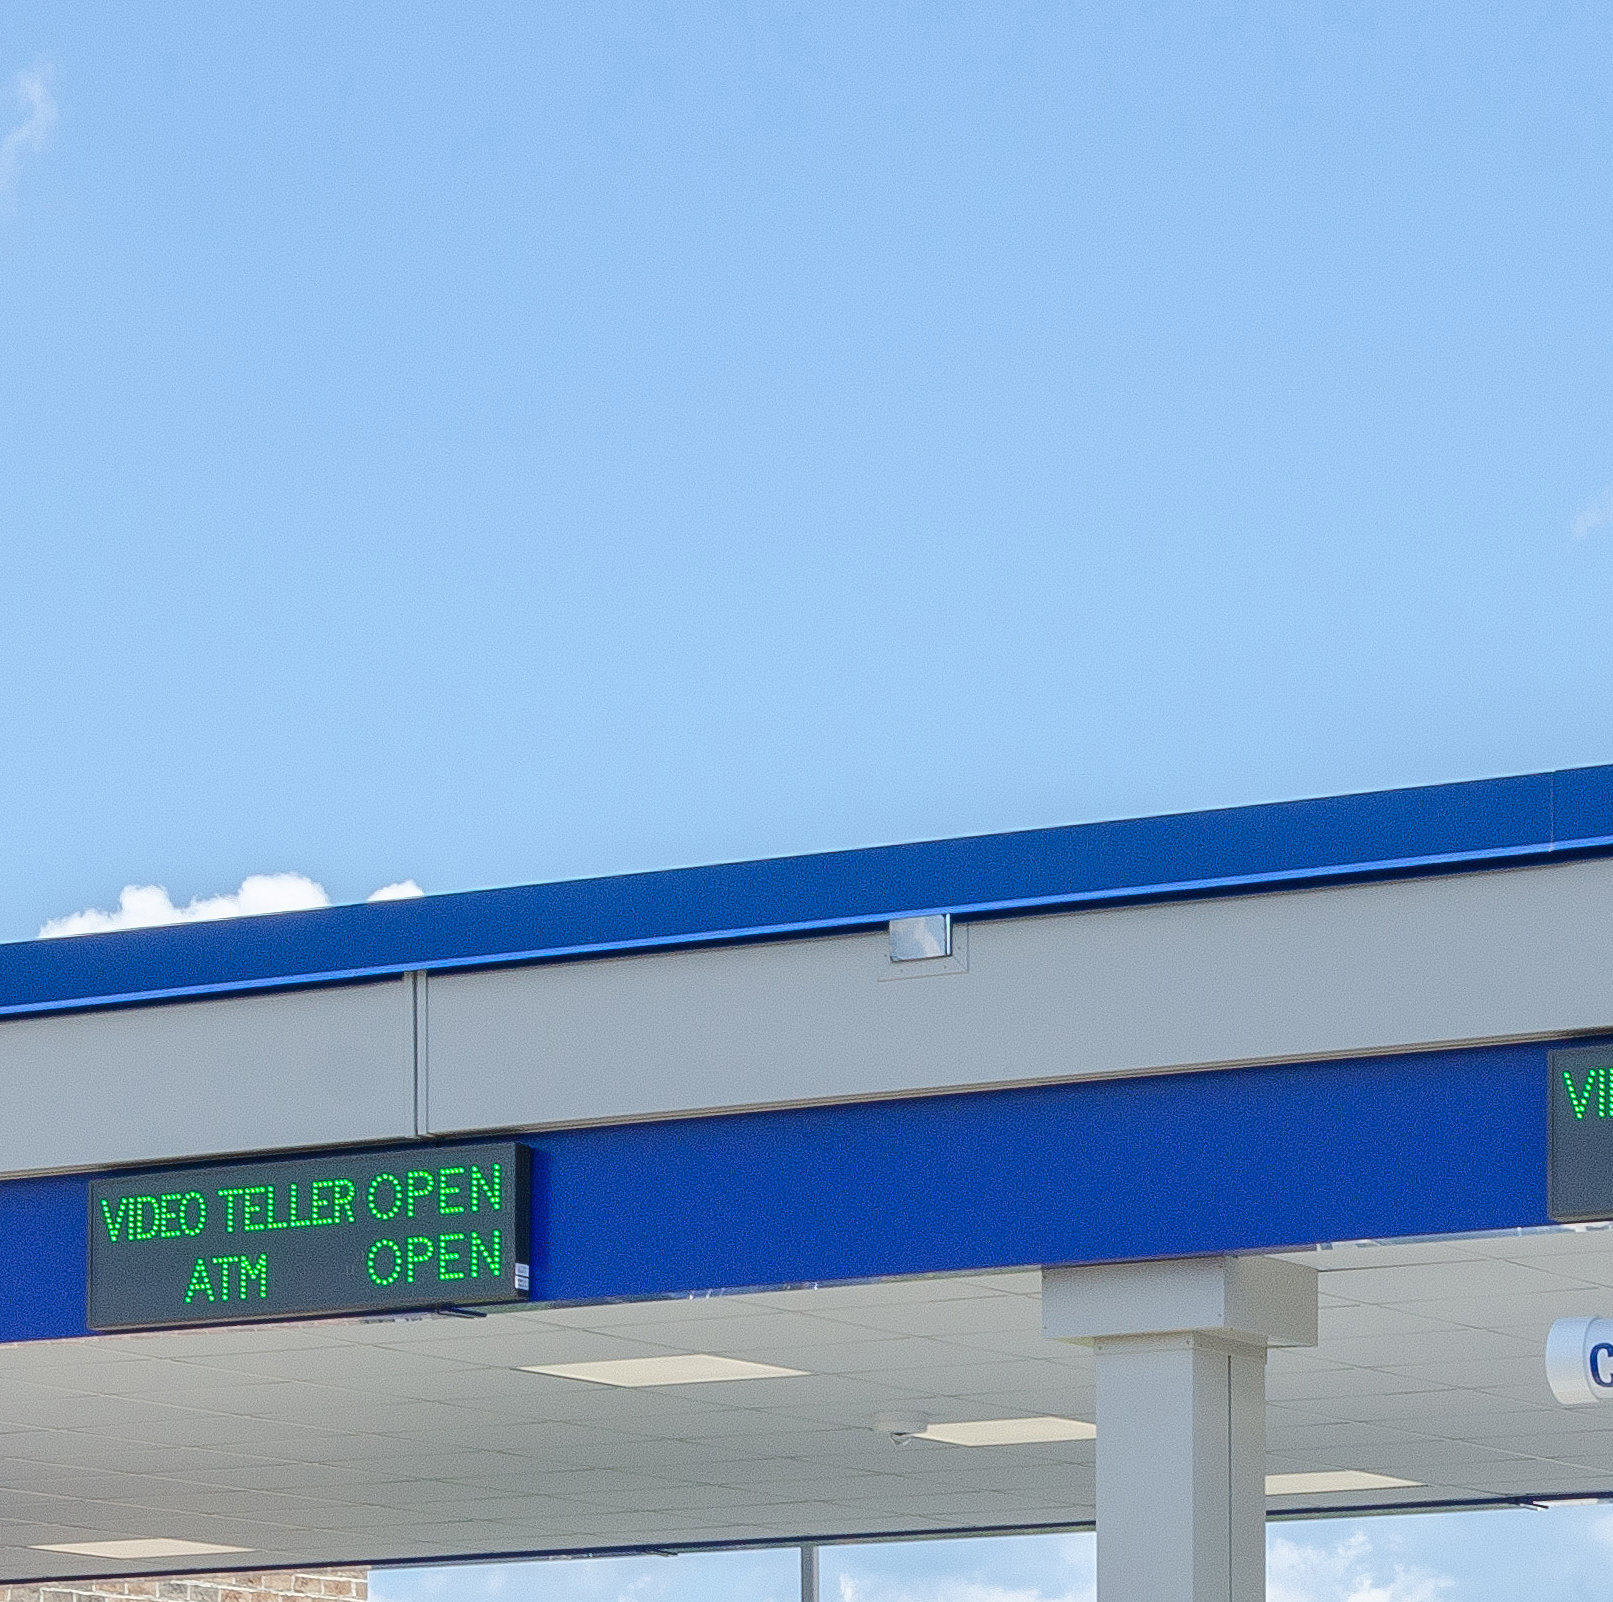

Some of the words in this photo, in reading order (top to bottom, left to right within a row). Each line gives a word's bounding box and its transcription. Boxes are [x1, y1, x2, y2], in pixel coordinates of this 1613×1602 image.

[101, 1191, 207, 1242] VIDEO
[218, 1178, 355, 1233] TELLER
[367, 1163, 502, 1221] OPEN
[184, 1252, 269, 1303] ATM
[366, 1229, 502, 1286] OPEN
